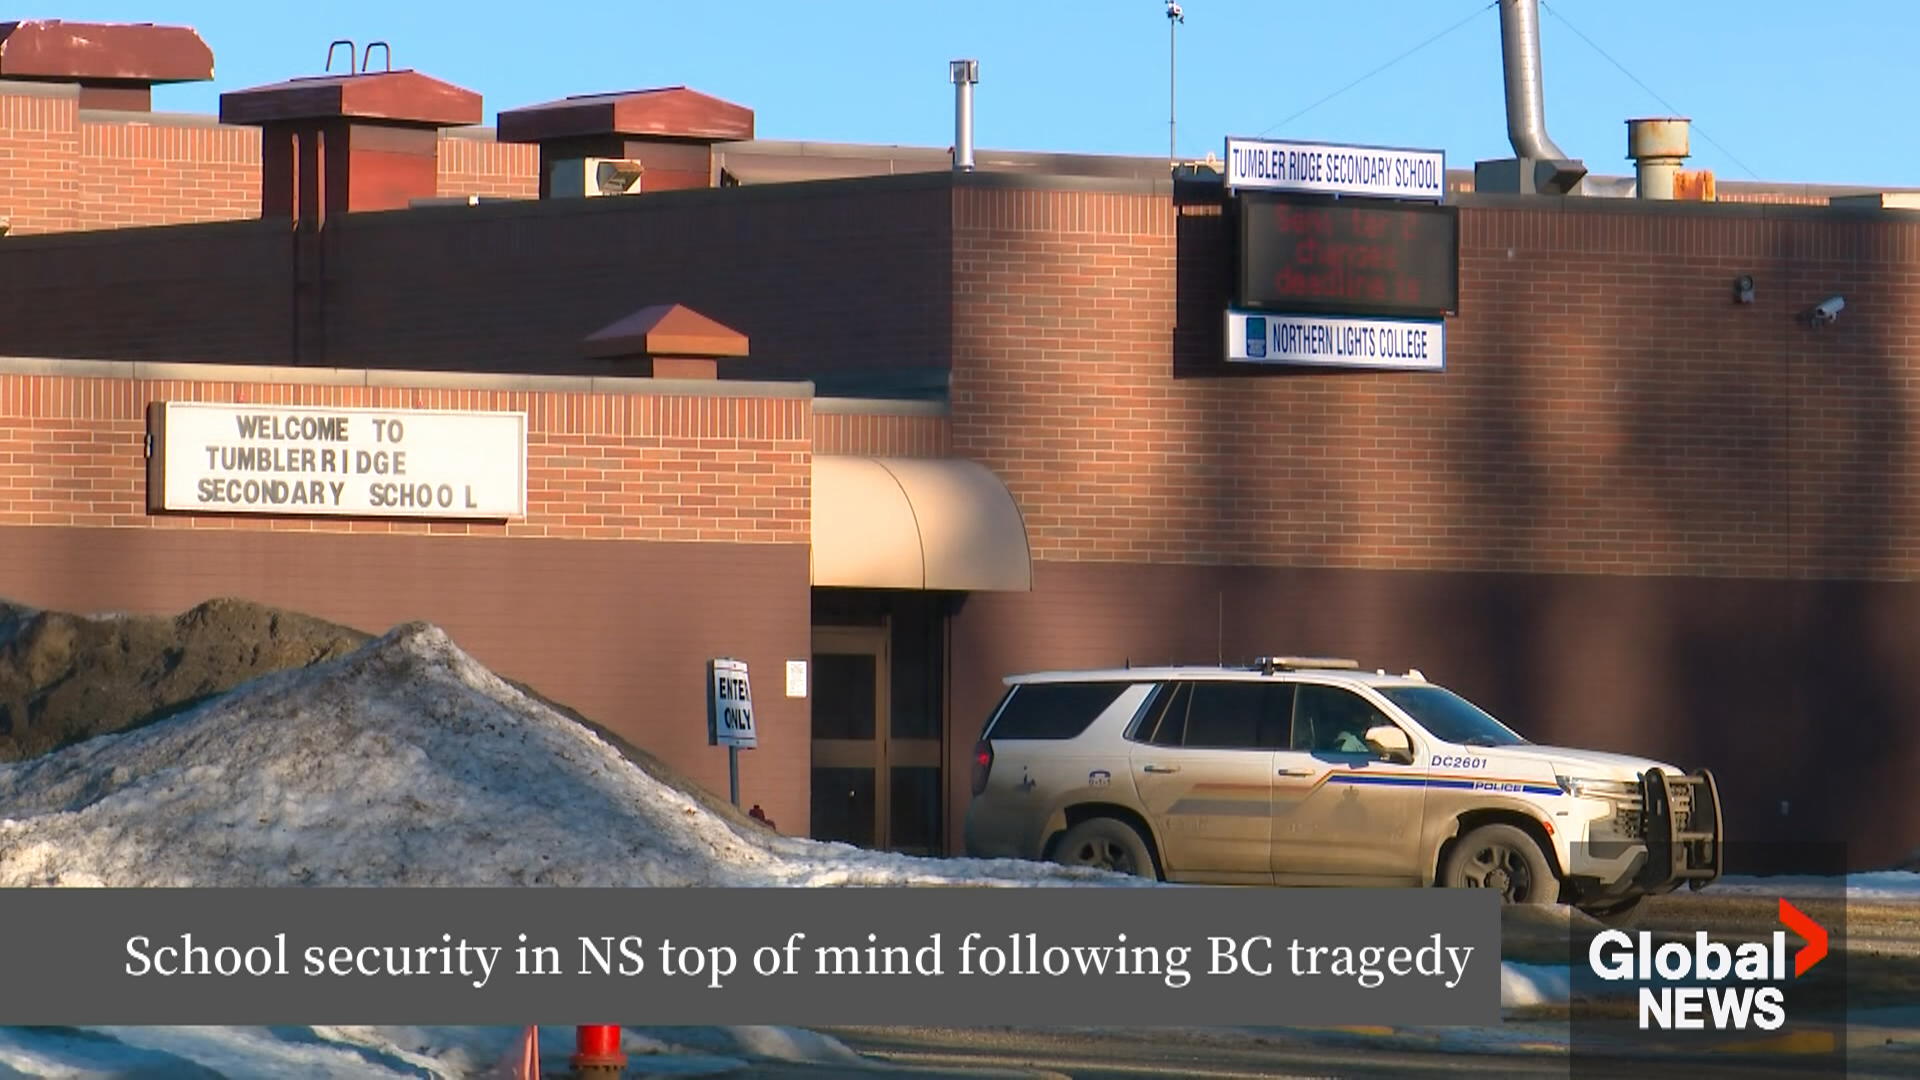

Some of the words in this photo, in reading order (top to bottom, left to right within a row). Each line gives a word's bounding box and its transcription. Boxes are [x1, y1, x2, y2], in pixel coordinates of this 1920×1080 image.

[1233, 148, 1286, 180] TUMBLER
[1289, 152, 1323, 183] RIDGE
[1326, 154, 1392, 187] SECONDARY
[1395, 158, 1439, 189] SCHOOL
[1273, 323, 1333, 355] NORTHERN
[1336, 327, 1375, 357] LIGHTS
[1379, 329, 1428, 359] COLLEGE
[236, 415, 349, 442] WELCOME
[372, 418, 404, 443] TO
[197, 479, 345, 507] SECONDARY
[369, 483, 478, 509] SCHOOL
[724, 707, 751, 730] ONLY
[1431, 755, 1487, 769] DC2601
[1474, 782, 1521, 793] POLICE
